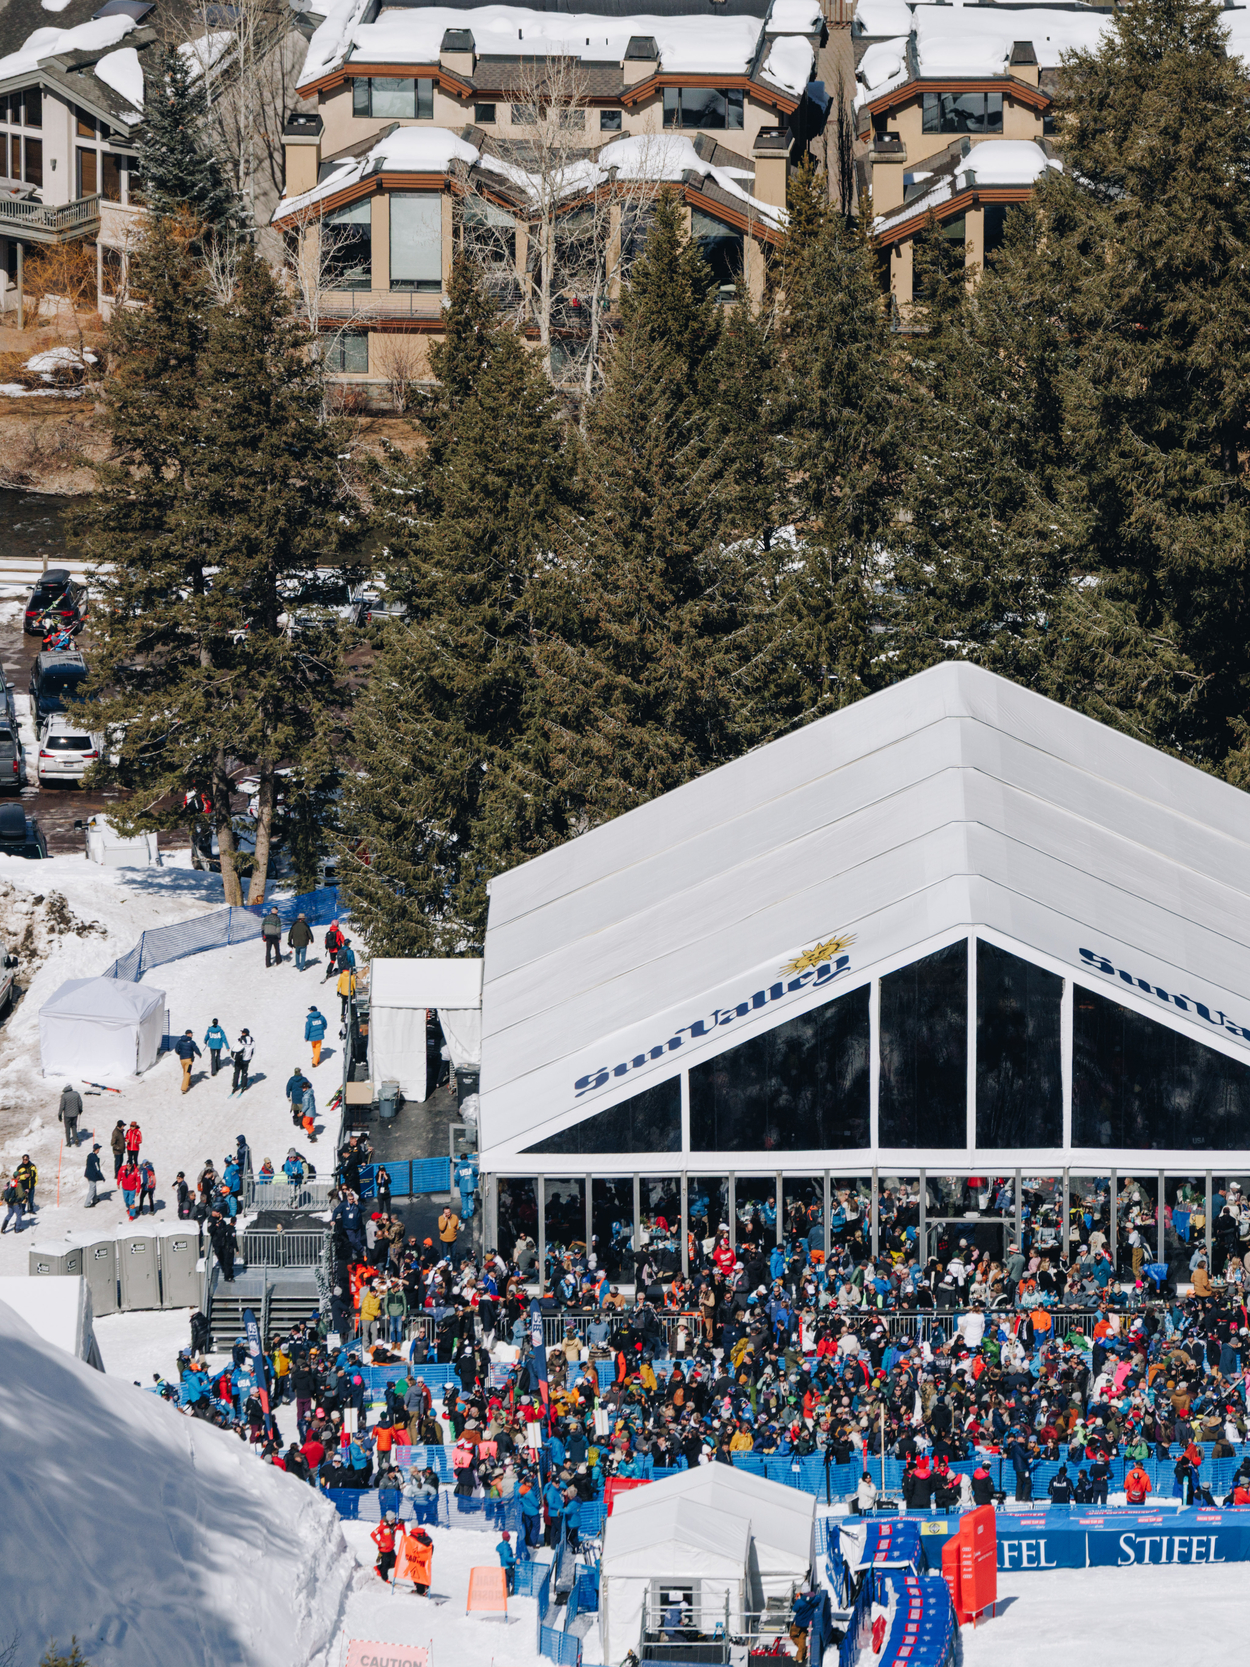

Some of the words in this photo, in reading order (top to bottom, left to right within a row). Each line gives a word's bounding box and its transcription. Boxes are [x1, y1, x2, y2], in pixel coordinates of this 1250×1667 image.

[1079, 947, 1192, 1012] Sun
[574, 1036, 685, 1098] Sun
[675, 955, 851, 1038] Valley
[999, 1539, 1057, 1568] FEL
[1118, 1533, 1226, 1565] STIFEL
[360, 1655, 422, 1667] CAUTION
